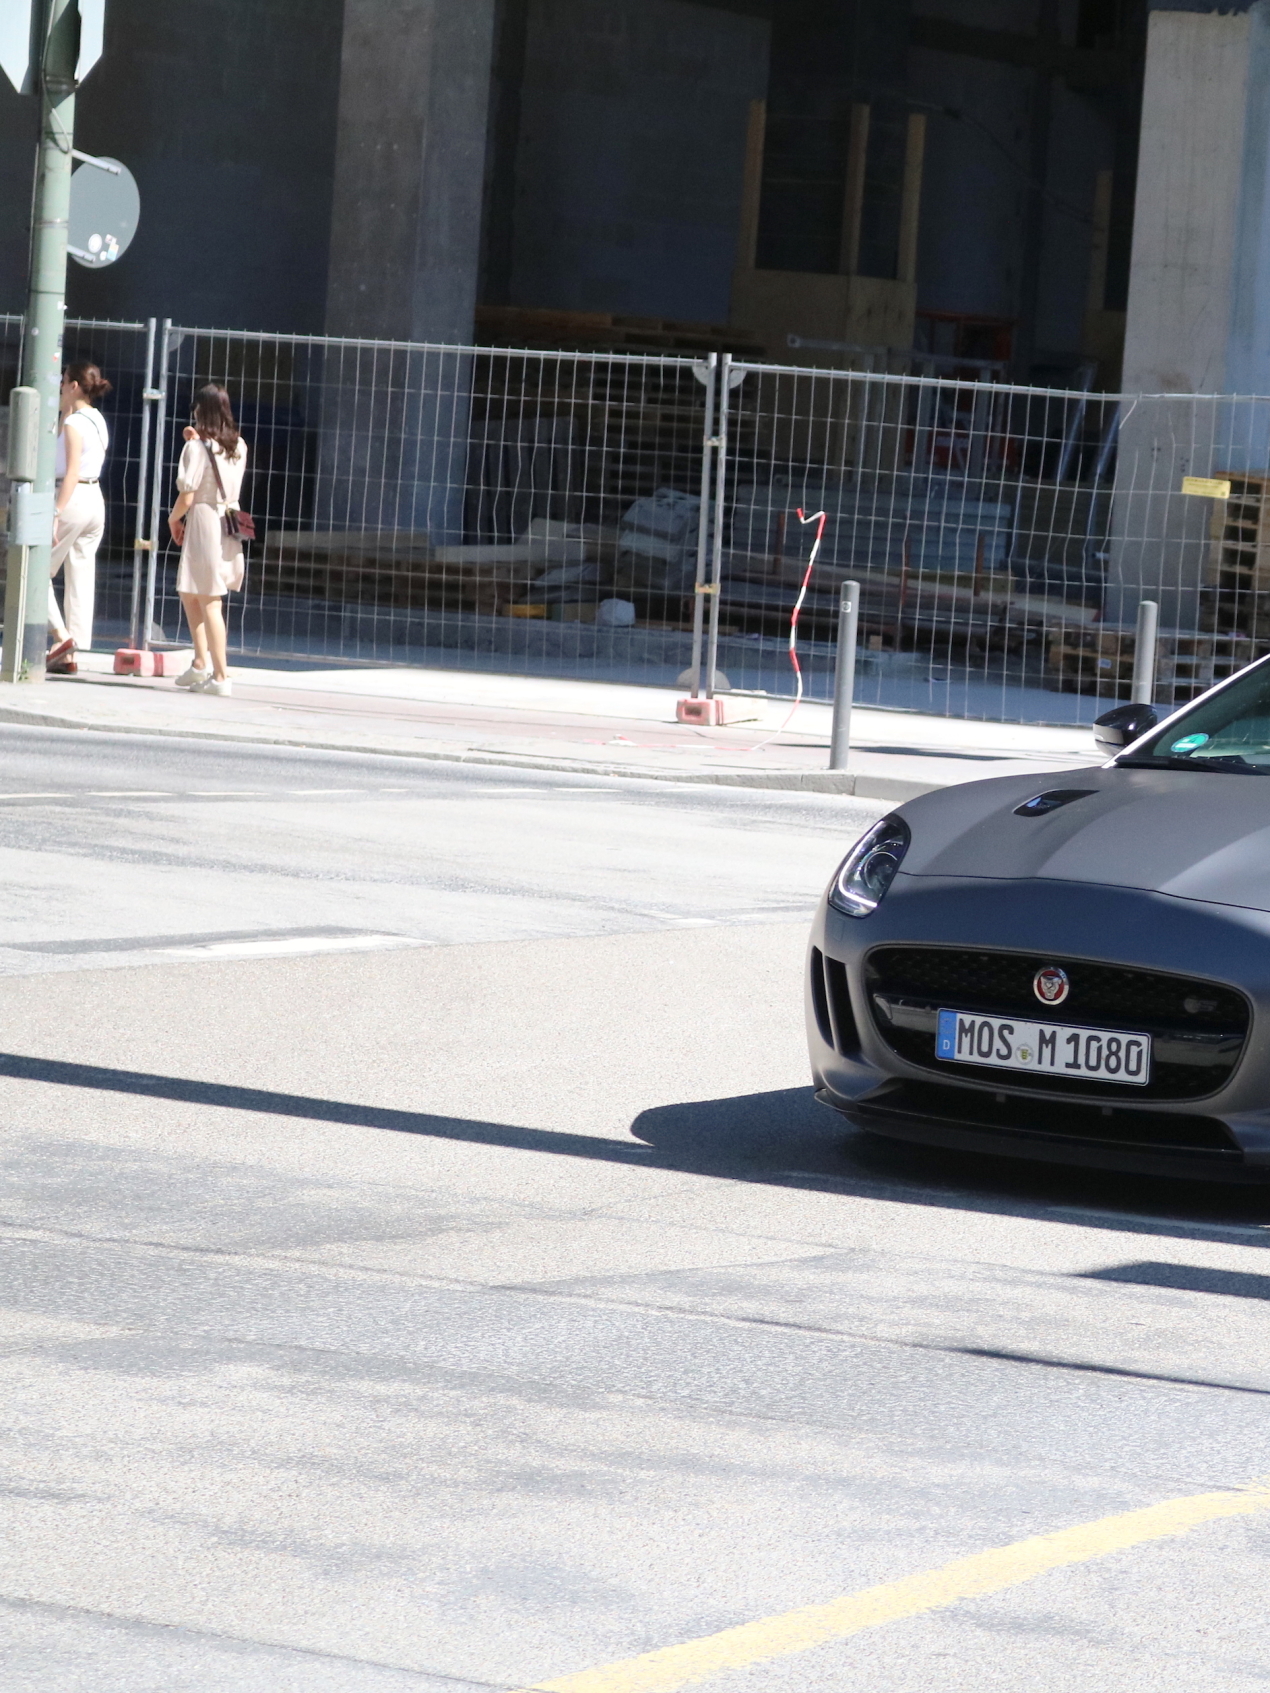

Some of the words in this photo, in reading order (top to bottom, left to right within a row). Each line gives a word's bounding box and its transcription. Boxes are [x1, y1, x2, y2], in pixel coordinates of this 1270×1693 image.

[942, 1039, 951, 1051] D
[956, 1017, 1015, 1061] MOS
[1037, 1028, 1057, 1067] M
[1064, 1032, 1143, 1077] 1080
